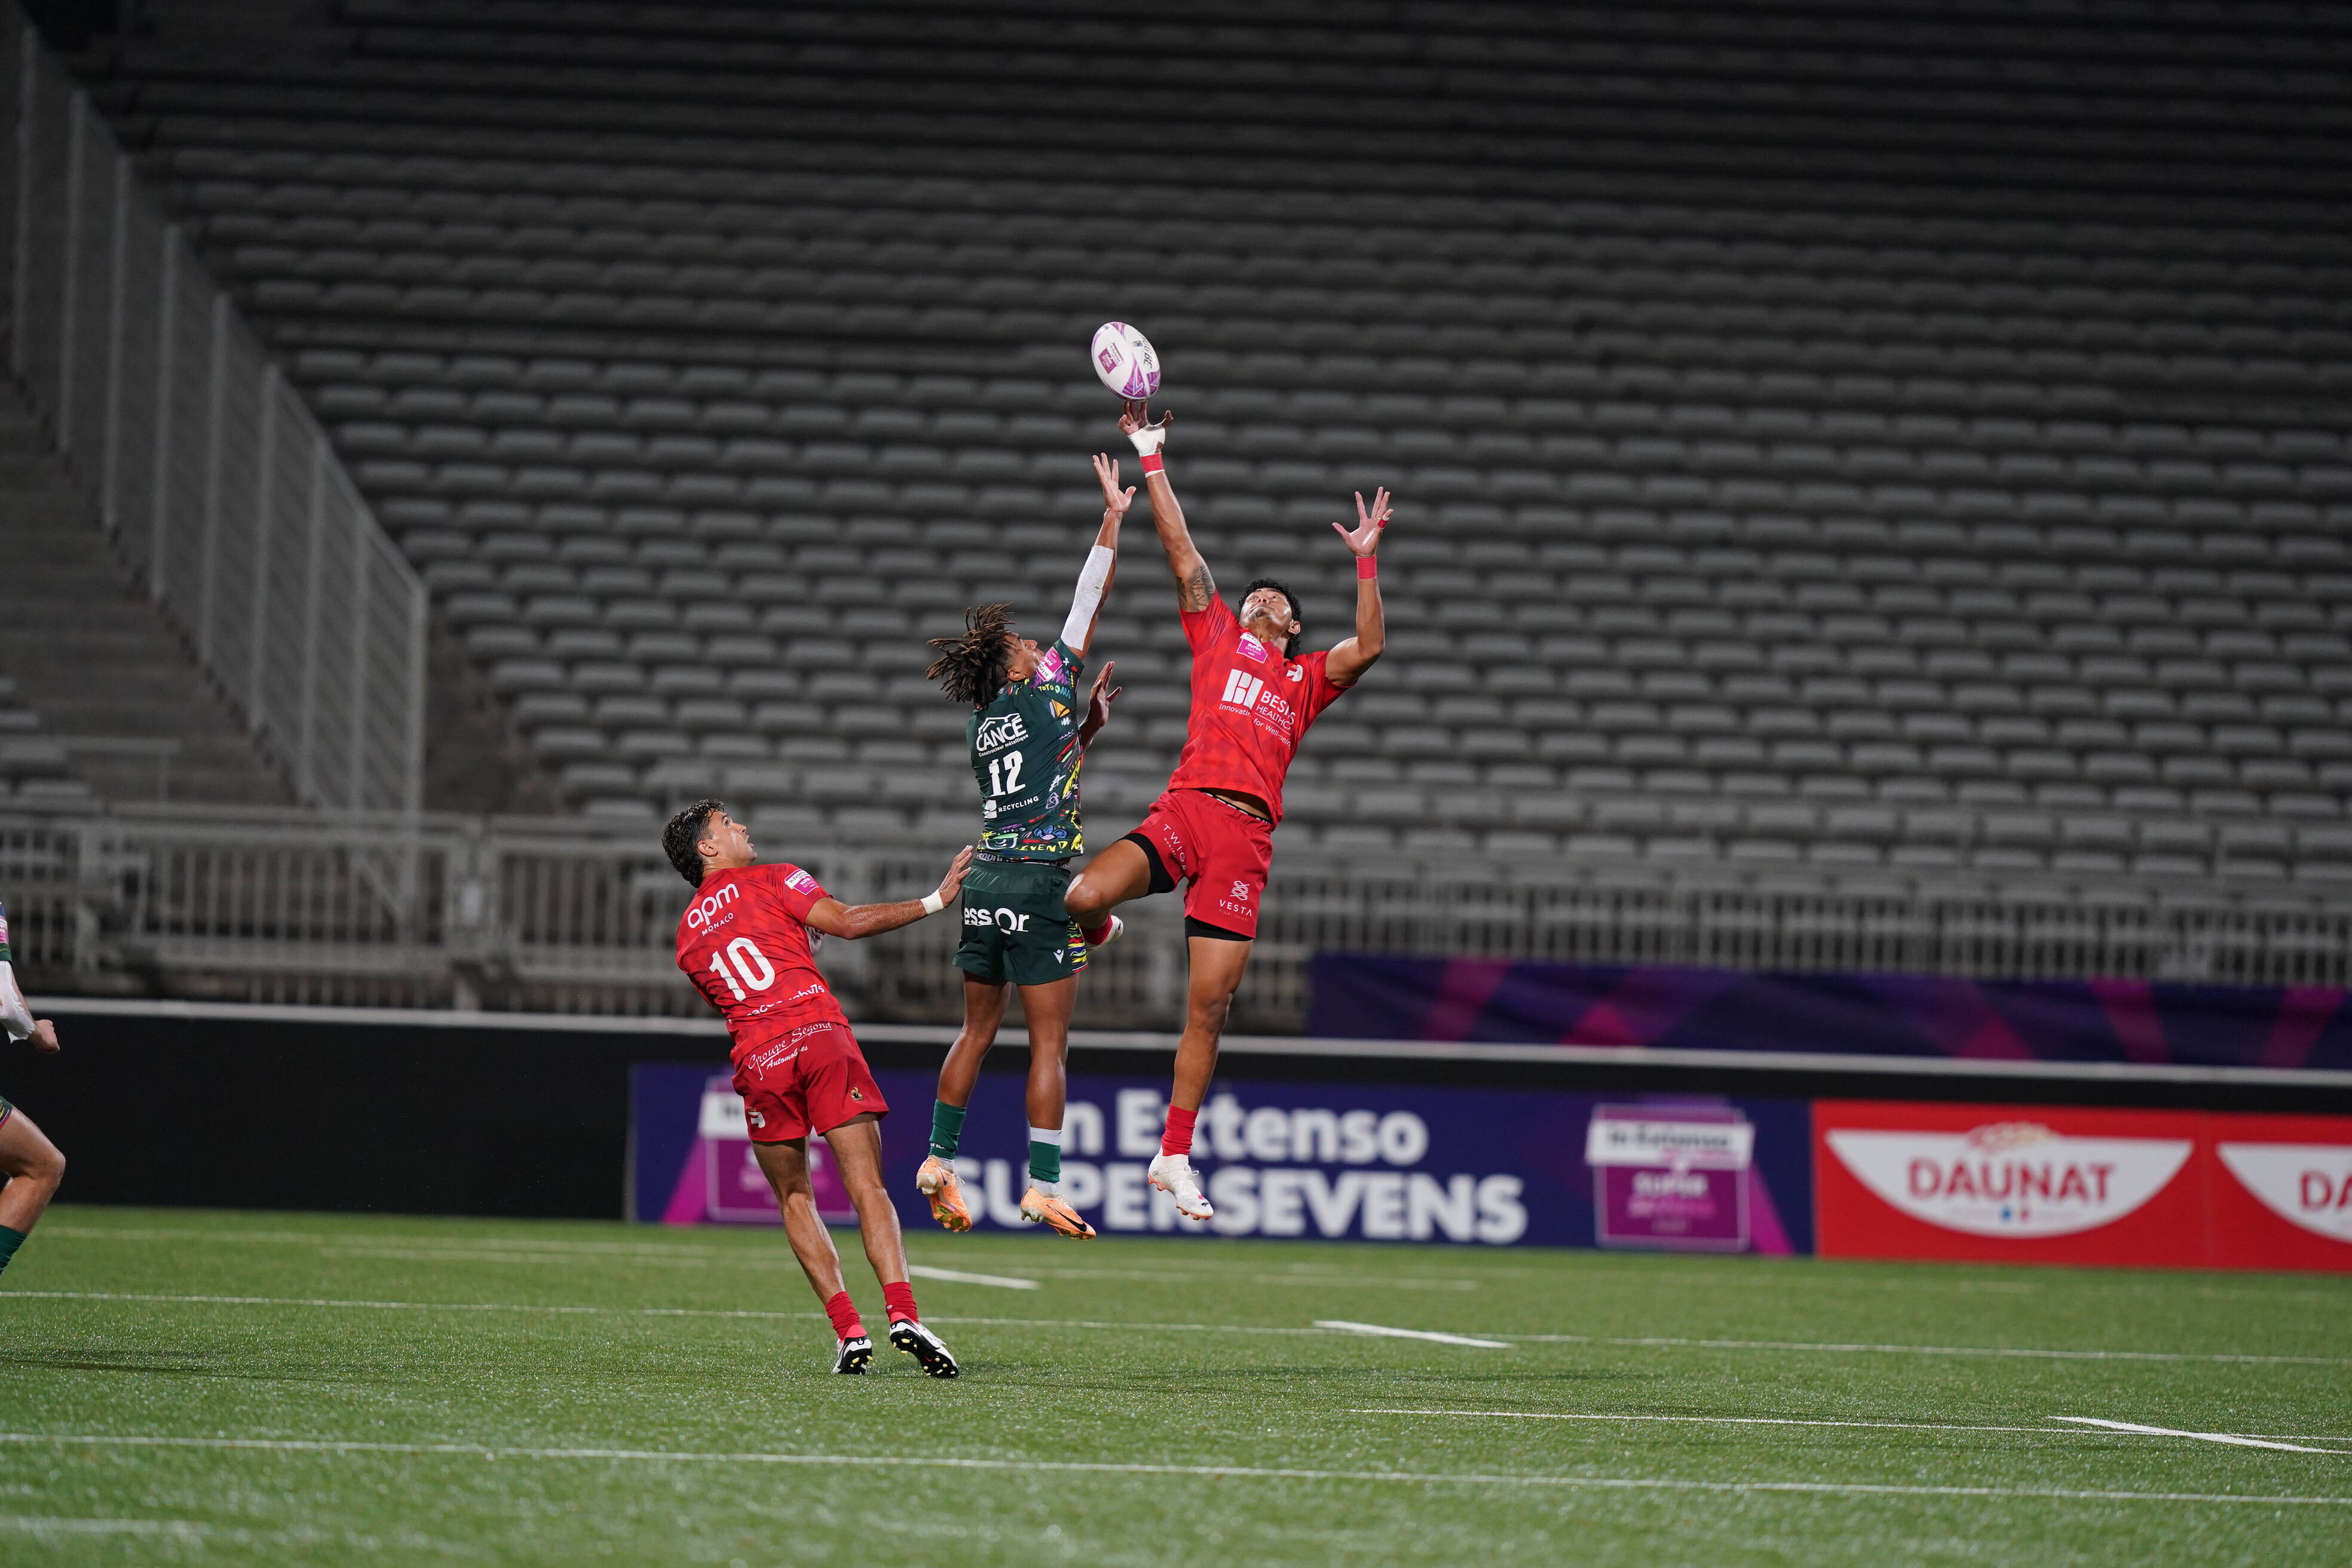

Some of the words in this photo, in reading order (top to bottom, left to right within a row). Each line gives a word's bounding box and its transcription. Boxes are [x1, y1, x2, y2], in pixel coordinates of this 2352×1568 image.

[1253, 718, 1264, 727] for
[1260, 690, 1296, 725] BESIS
[976, 717, 1027, 752] CANCE
[978, 745, 1004, 757] Constructeur
[1004, 734, 1029, 748] métallique
[988, 751, 1025, 797] 12
[998, 795, 1040, 813] RECYCLING
[687, 883, 740, 929] apm
[1220, 899, 1252, 917] VESTA
[702, 912, 734, 936] MONACO
[709, 937, 776, 1002] 10
[748, 1040, 786, 1080] Groupe
[792, 1022, 832, 1043] Segond
[766, 1046, 808, 1070] Automobes
[1907, 1157, 2114, 1203] DAUNAT
